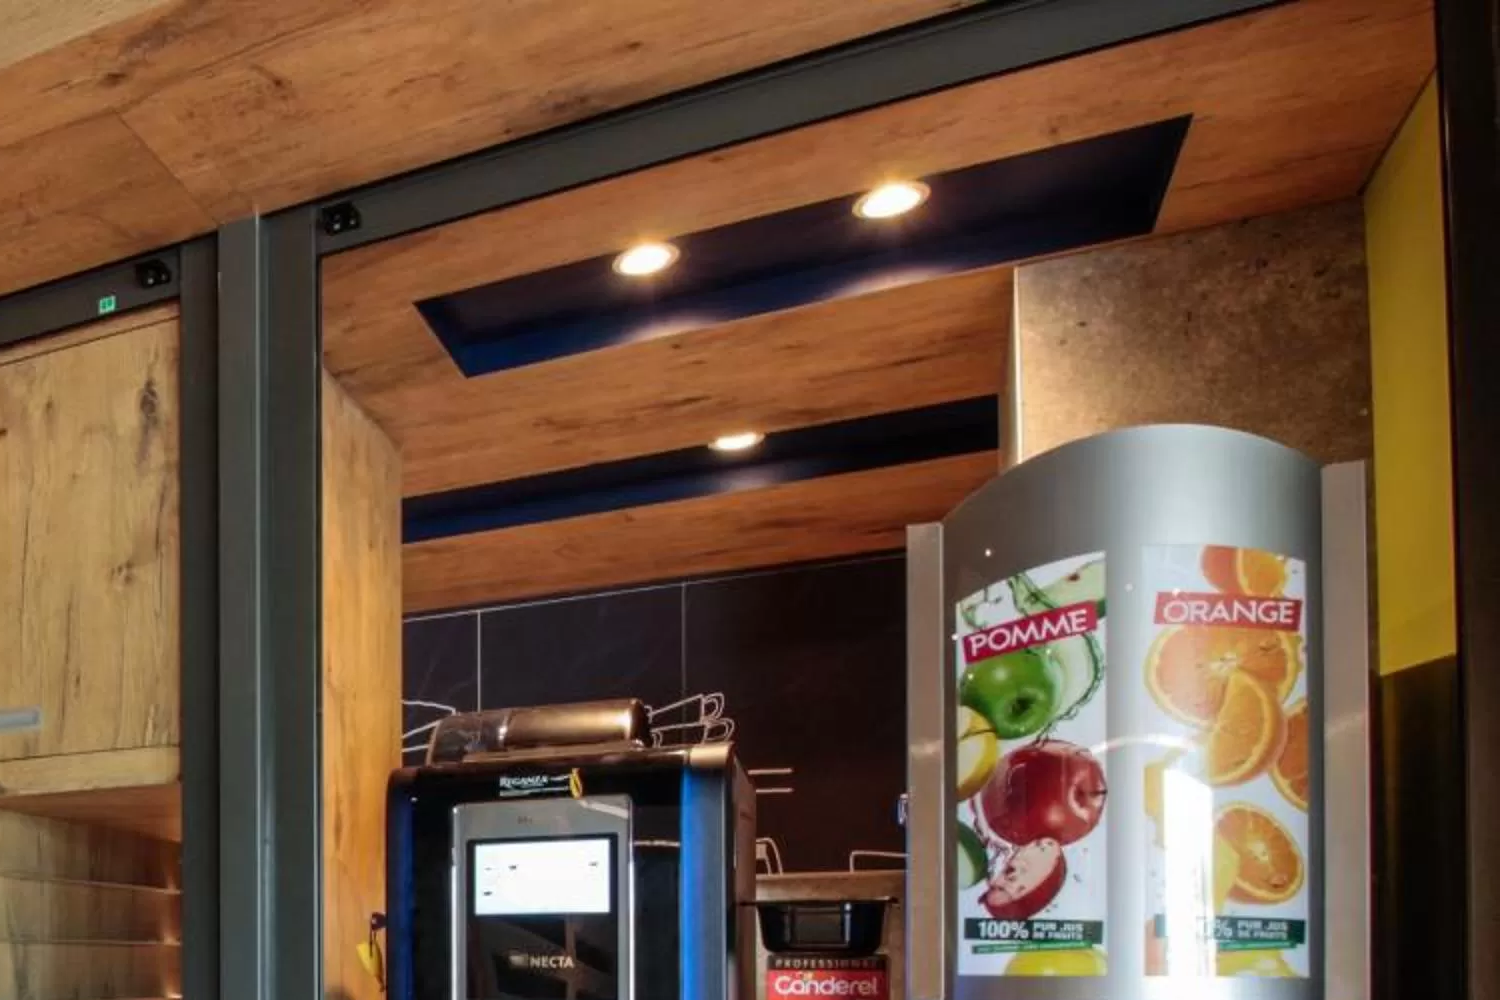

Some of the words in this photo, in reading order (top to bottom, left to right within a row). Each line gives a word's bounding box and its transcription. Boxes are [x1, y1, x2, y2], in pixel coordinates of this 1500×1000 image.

[1162, 600, 1295, 624] ORANGE
[969, 608, 1088, 657] POMME
[978, 920, 1029, 939] 100%
[529, 955, 574, 969] NECTA
[774, 975, 878, 996] Canderel
